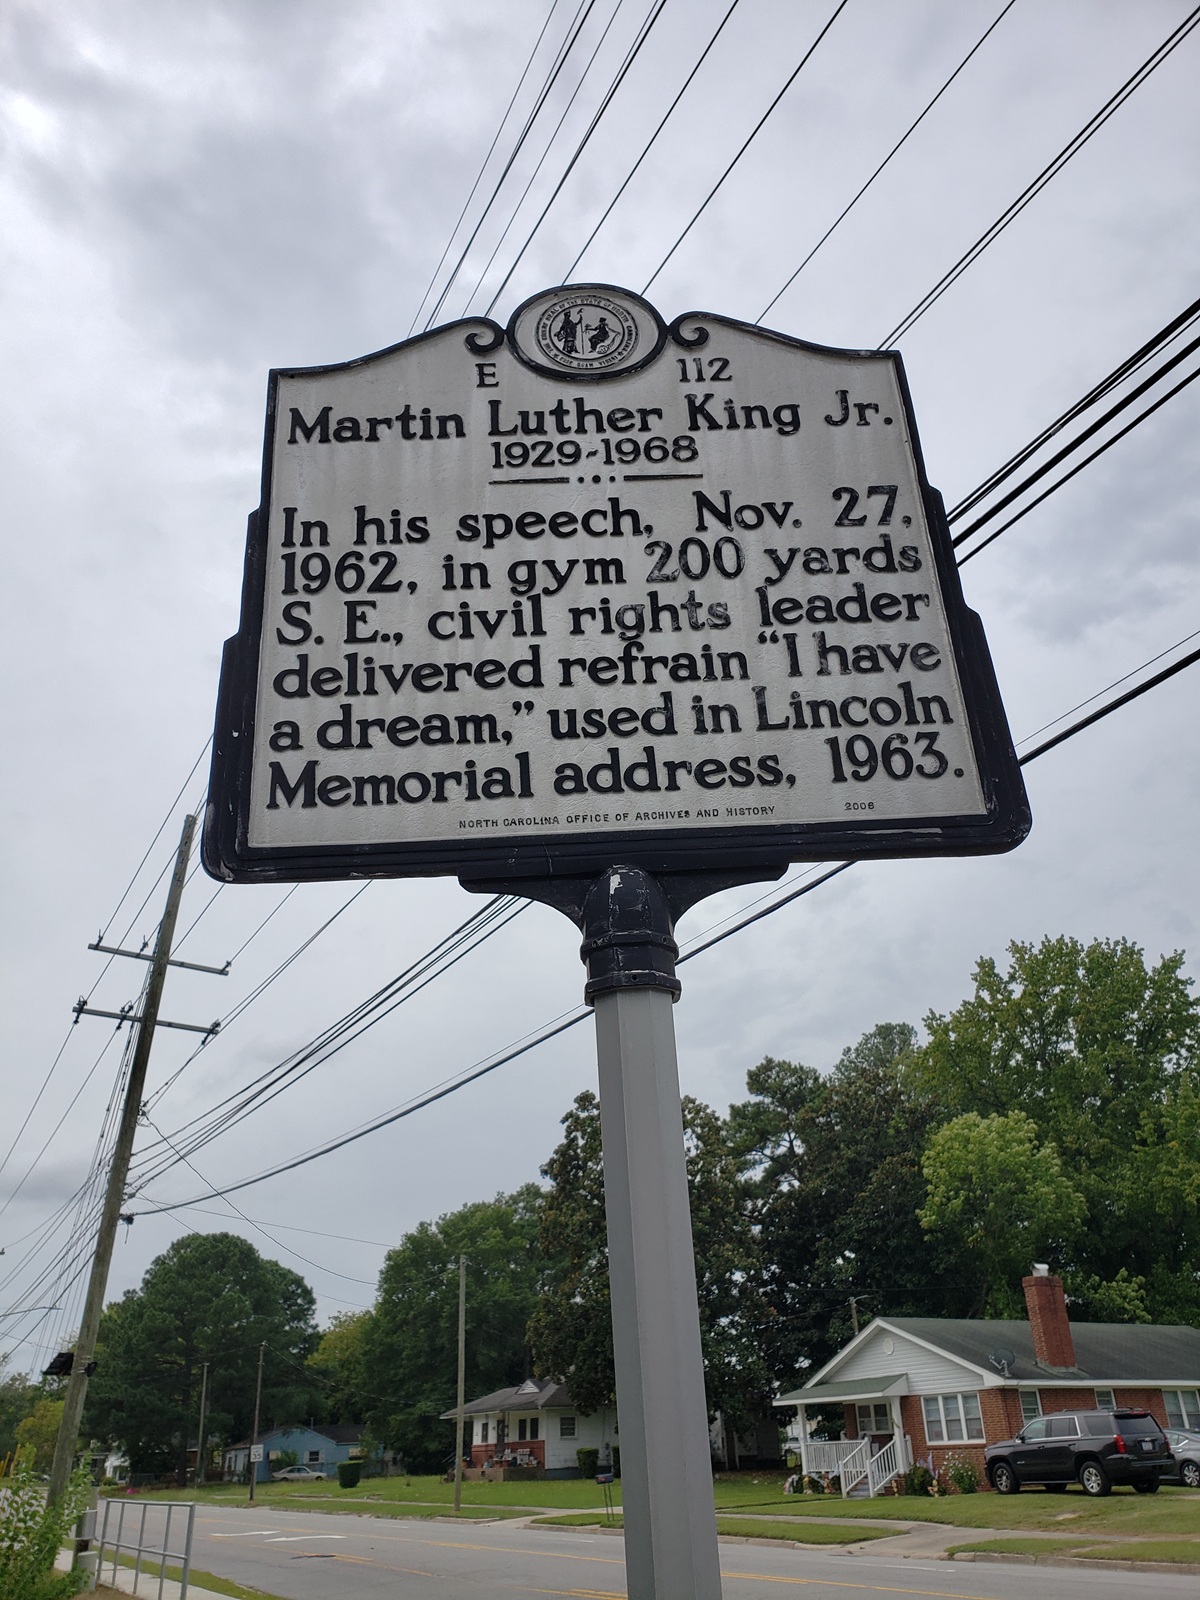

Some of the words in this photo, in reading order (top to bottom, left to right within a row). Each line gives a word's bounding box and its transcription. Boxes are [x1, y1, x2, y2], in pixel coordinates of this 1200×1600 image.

[475, 363, 500, 389] E
[676, 357, 733, 384] 112
[286, 404, 467, 446] Martin
[487, 396, 663, 437] Luther
[683, 392, 801, 437] King
[823, 389, 894, 428] Jr.
[490, 435, 700, 470] 1929-1968
[280, 506, 331, 549] In
[352, 504, 431, 547] his
[455, 496, 654, 551] speech,
[691, 489, 803, 533] Nov.
[831, 484, 913, 529] 27,
[280, 550, 419, 597] 1962,
[441, 553, 492, 592] in
[506, 556, 628, 598] gym
[643, 535, 746, 584] 200
[763, 532, 924, 587] yards
[275, 600, 325, 647] S.
[343, 599, 404, 648] E.,
[427, 592, 548, 641] civil
[567, 589, 732, 641] rights
[754, 581, 931, 629] leader
[272, 643, 545, 700] delivered
[557, 640, 752, 689] refrain
[811, 630, 943, 677] have
[267, 720, 304, 752] a
[546, 690, 679, 742] used
[691, 694, 743, 736] in
[751, 680, 954, 733] Lincoln
[265, 751, 535, 810] Memorial
[552, 745, 797, 797] address,
[823, 731, 966, 784] 1963.
[458, 819, 499, 829] NORTH
[503, 815, 560, 827] CAROLINA
[566, 813, 610, 824] OFFICE
[615, 812, 629, 821] OF
[635, 808, 691, 821] ARCHIVES
[696, 808, 719, 819] AND
[726, 805, 775, 817] HISTORY
[844, 801, 875, 811] 2006
